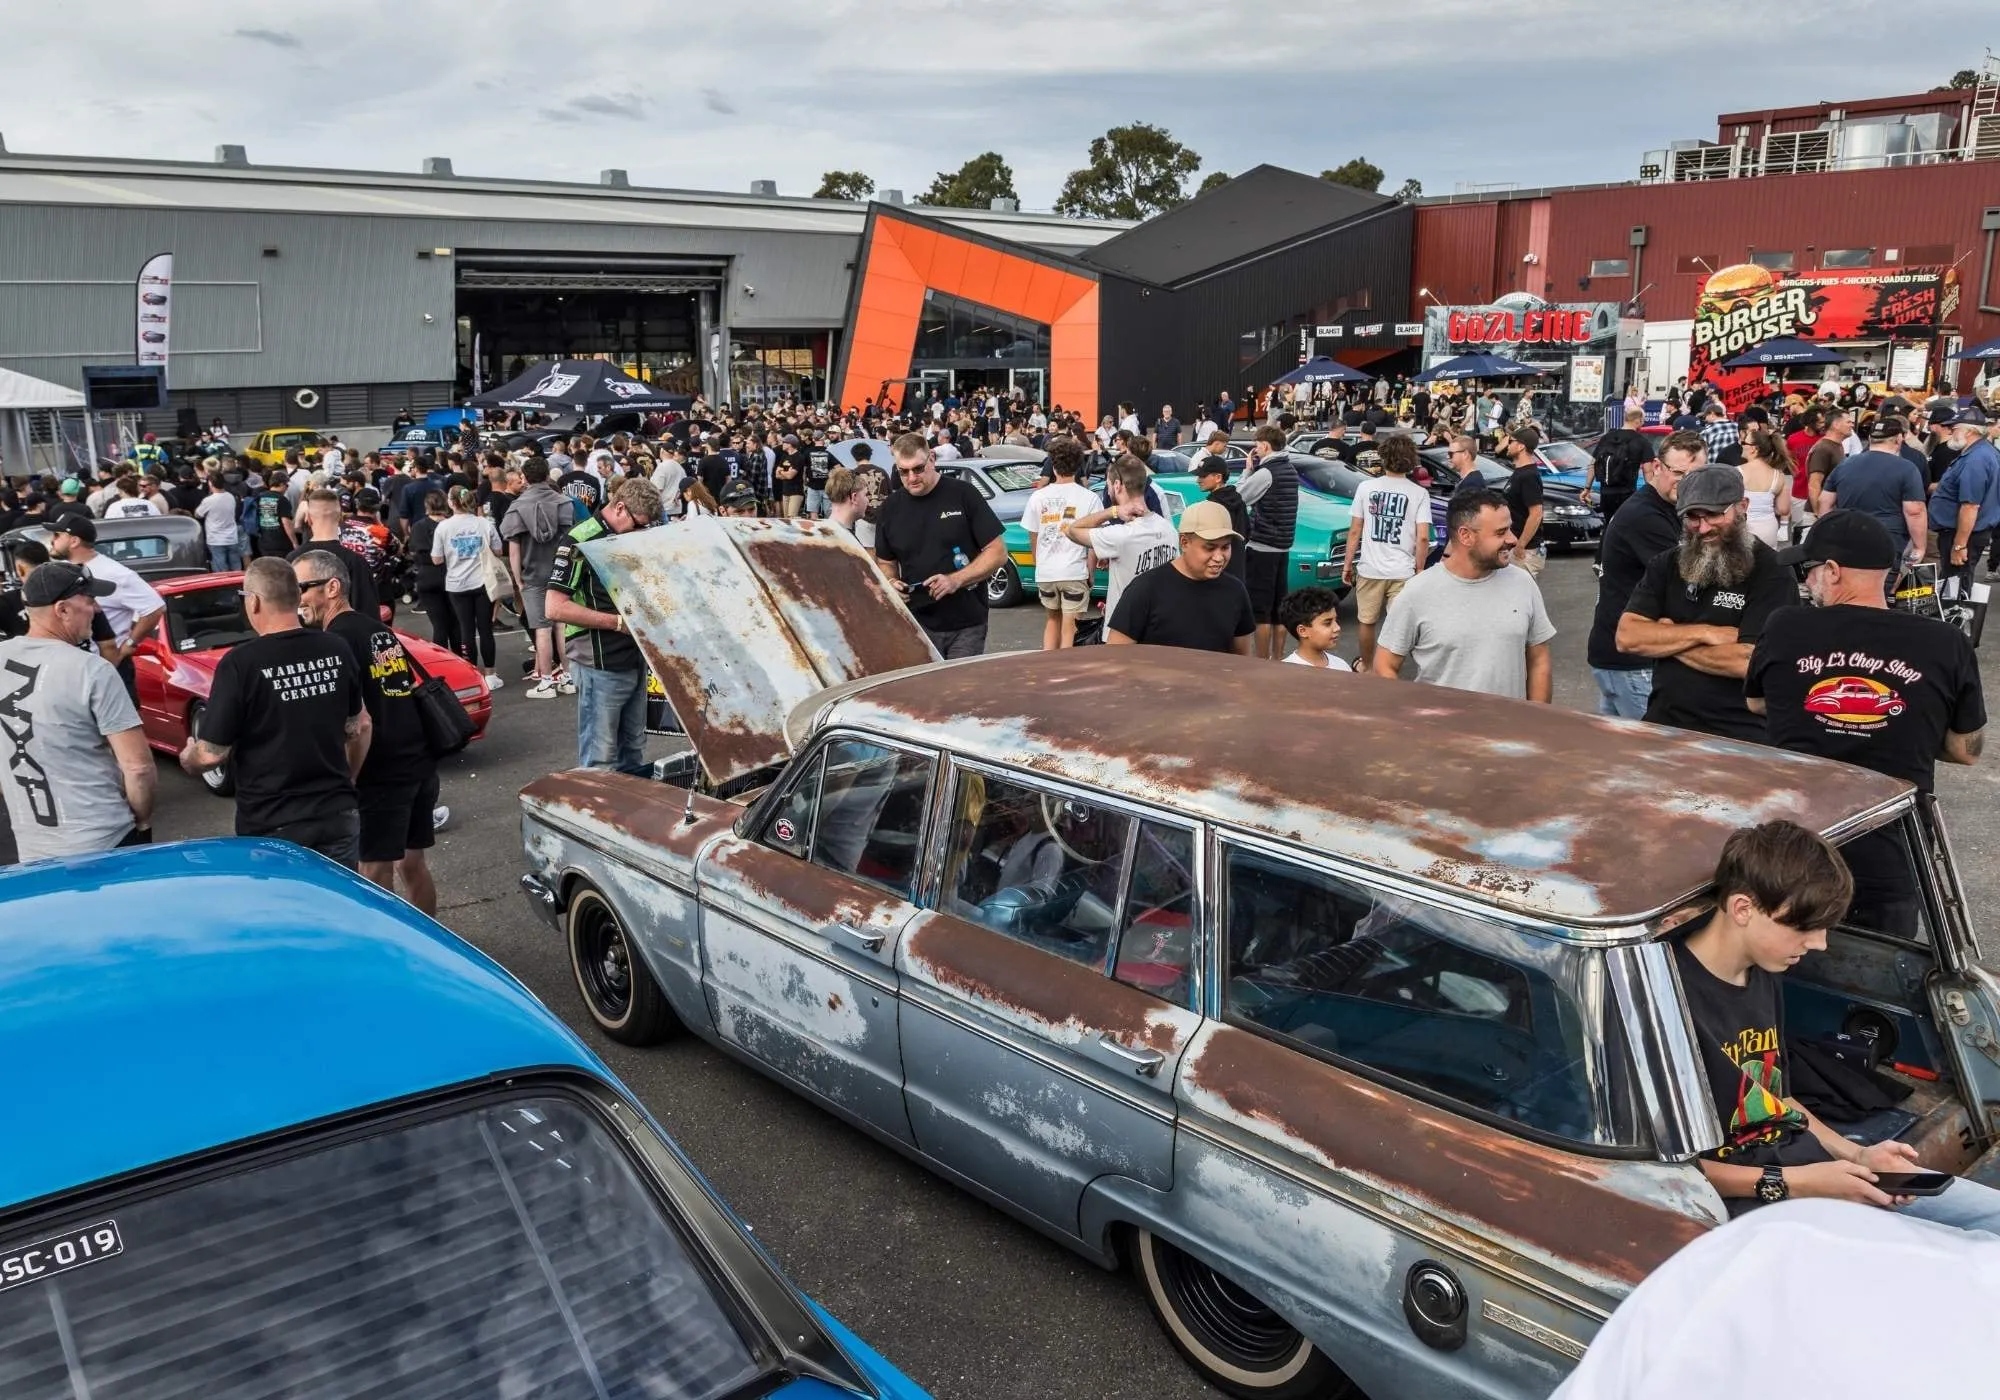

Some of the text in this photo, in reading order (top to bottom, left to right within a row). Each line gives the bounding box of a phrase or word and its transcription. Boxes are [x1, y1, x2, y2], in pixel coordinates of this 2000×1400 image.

[1696, 288, 1816, 345] BURGER
[1881, 288, 1935, 320] FRESH
[1894, 302, 1936, 325] JUICY
[1710, 312, 1796, 360] HOUSE
[1725, 377, 1764, 401] FRESH
[1369, 490, 1409, 520] SHED
[1370, 515, 1402, 545] LIFE
[1135, 548, 1152, 575] LOS
[261, 655, 342, 679] WARRAGUL
[272, 668, 339, 690] EXHAUST
[1796, 651, 1923, 685] Big L's Chop Shop
[281, 681, 336, 701] CENTRE
[0, 1229, 115, 1285] SC-019
